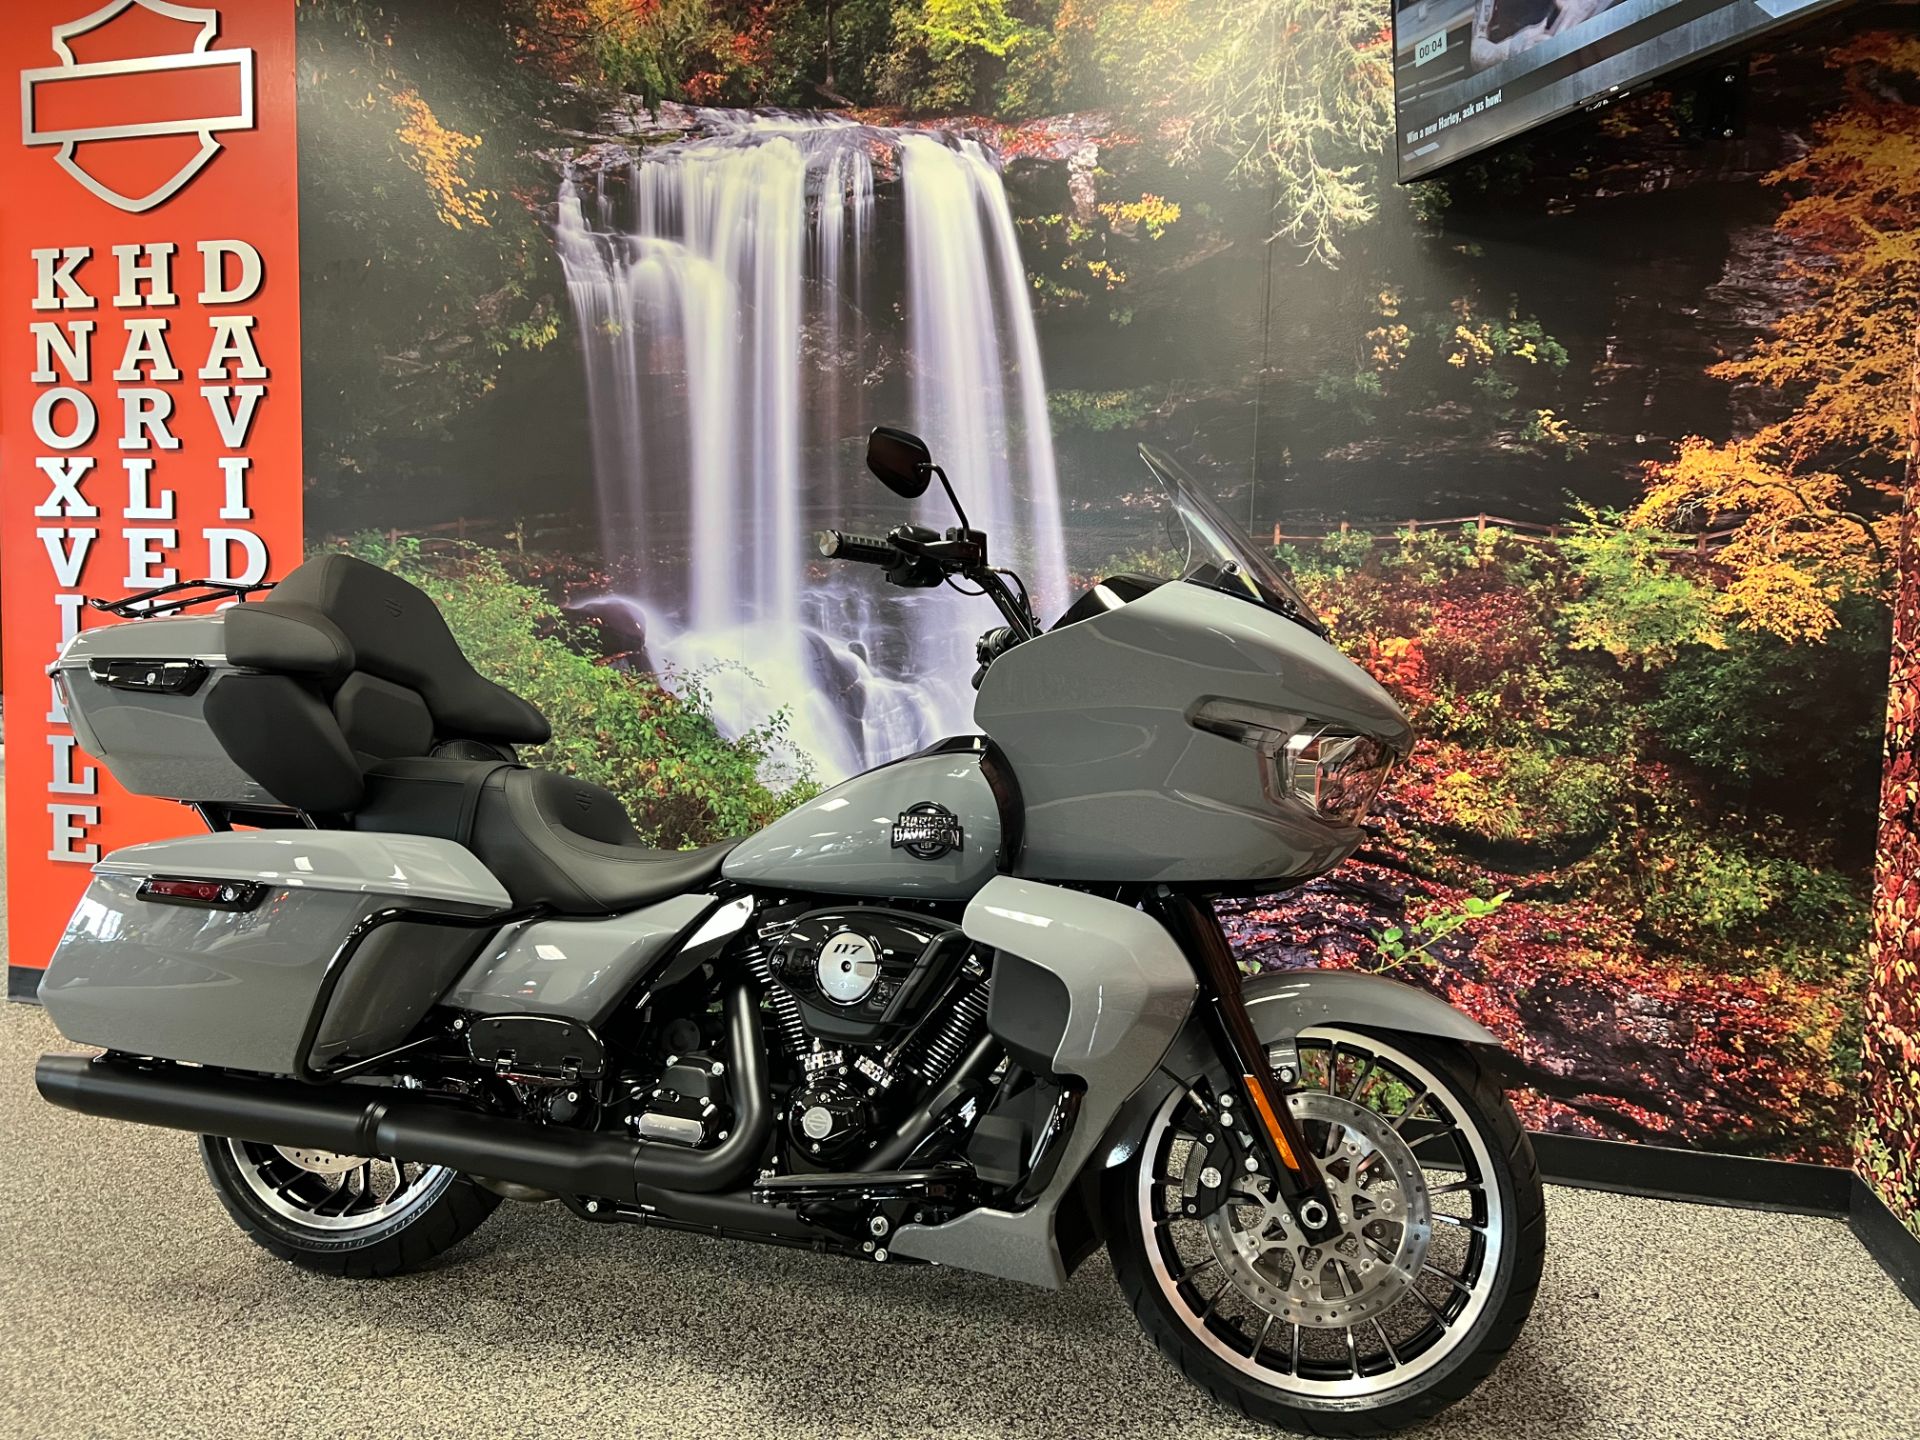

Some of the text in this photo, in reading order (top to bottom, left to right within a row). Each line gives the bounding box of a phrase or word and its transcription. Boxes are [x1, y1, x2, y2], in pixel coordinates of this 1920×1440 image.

[1406, 89, 1502, 144] Win a new Harley, ask us how!
[111, 242, 182, 617] HARLE
[197, 239, 268, 612] DAVID
[893, 827, 960, 847] DAVIDSON
[832, 943, 865, 955] 117
